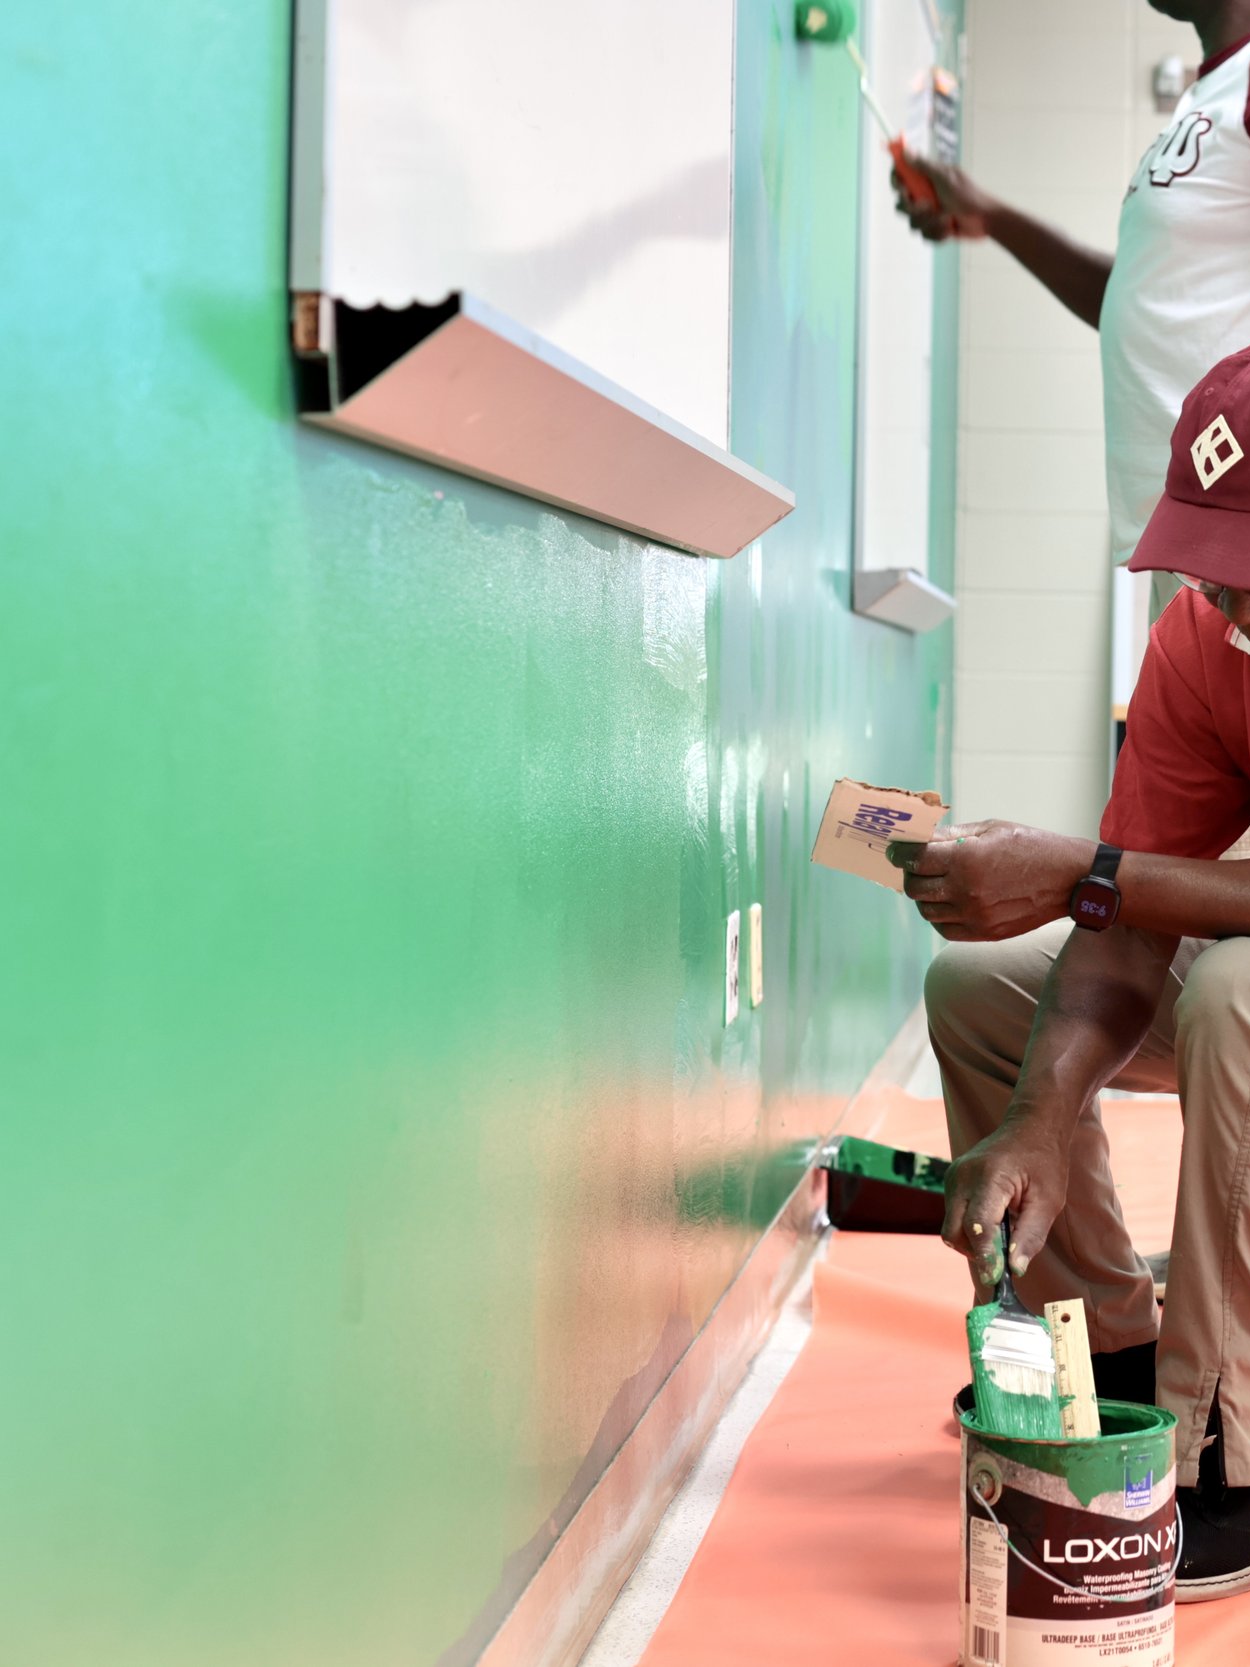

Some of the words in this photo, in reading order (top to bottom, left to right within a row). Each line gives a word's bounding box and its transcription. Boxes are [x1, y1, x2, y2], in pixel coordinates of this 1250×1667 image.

[1043, 1530, 1162, 1563] LOXON
[1083, 1572, 1133, 1584] Waterproofing
[1134, 1567, 1157, 1579] Masonry
[1042, 1634, 1078, 1644] ULTRADEEP
[1080, 1634, 1096, 1643] BASE
[1101, 1633, 1116, 1642] BASE
